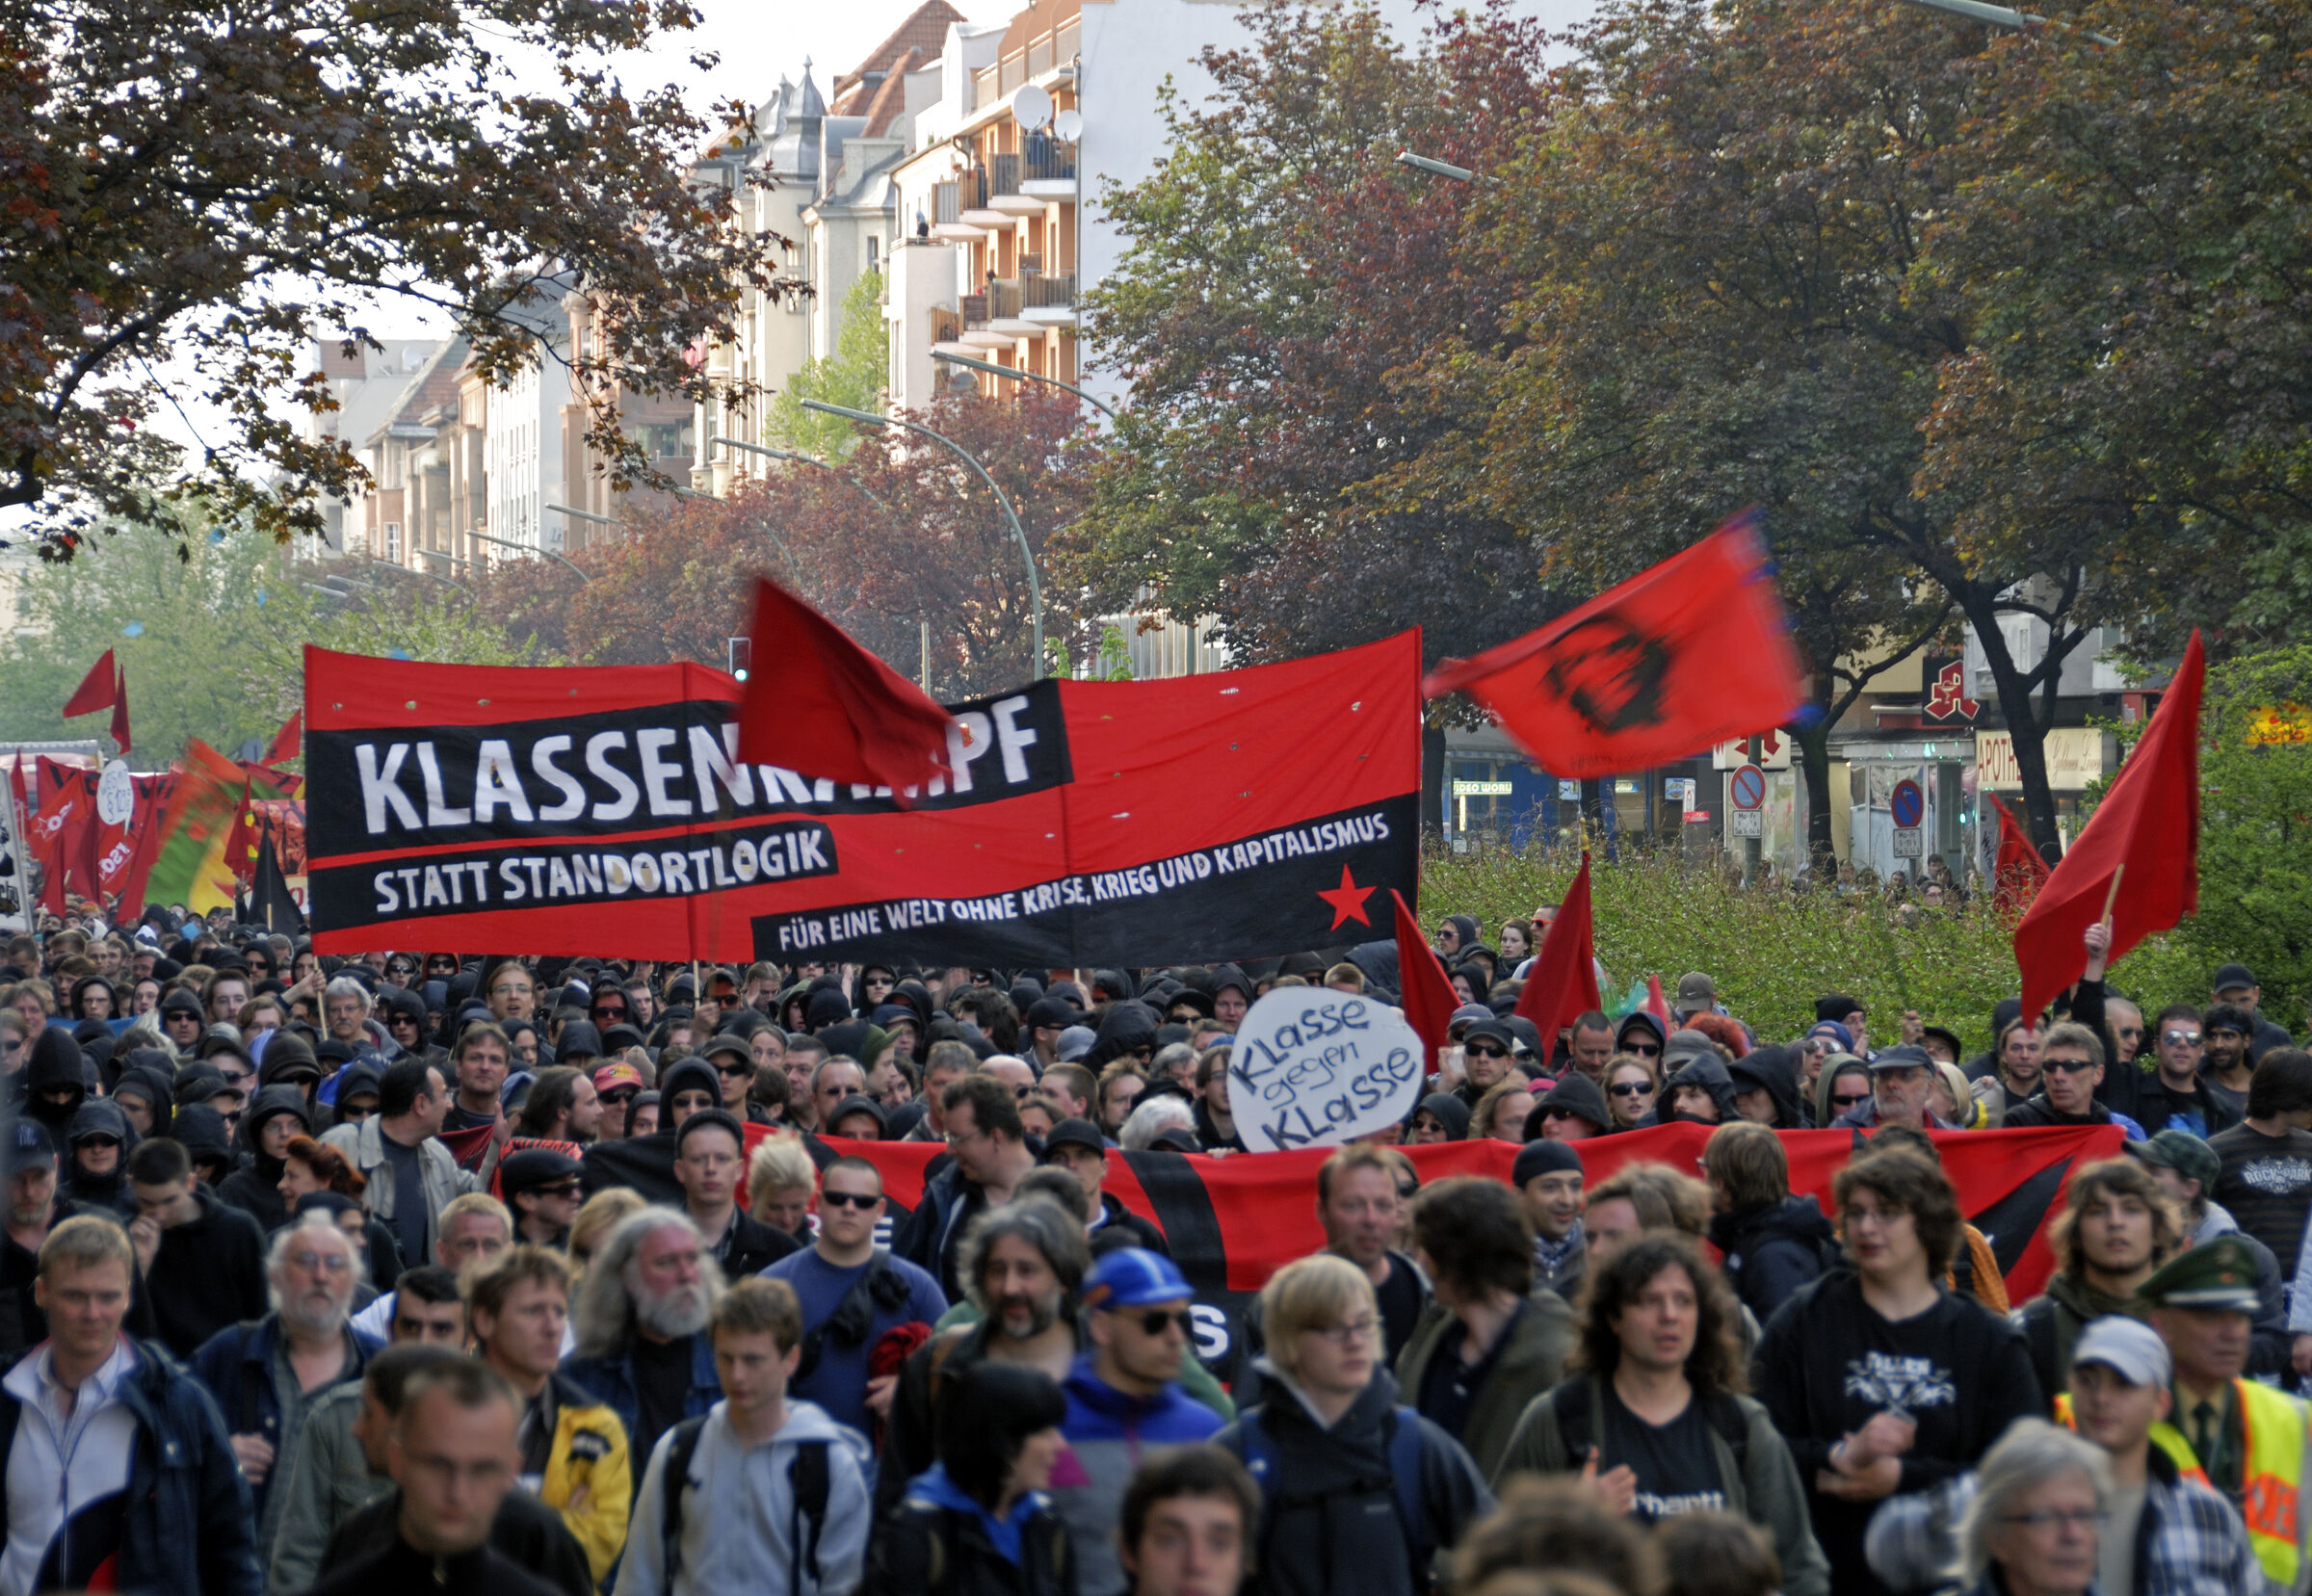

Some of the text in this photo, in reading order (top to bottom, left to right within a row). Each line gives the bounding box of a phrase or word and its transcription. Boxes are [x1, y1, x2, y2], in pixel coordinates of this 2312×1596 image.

[355, 694, 1038, 835] KLASSENPF
[374, 829, 829, 914] STATT STANDORTLOGIK
[778, 811, 1391, 951] FÜR EINE WELT OHNE KRISE, KRIEG UND KAPITALISMUS
[1263, 1041, 1360, 1111] gegen
[1628, 1490, 1724, 1516] rhartt
